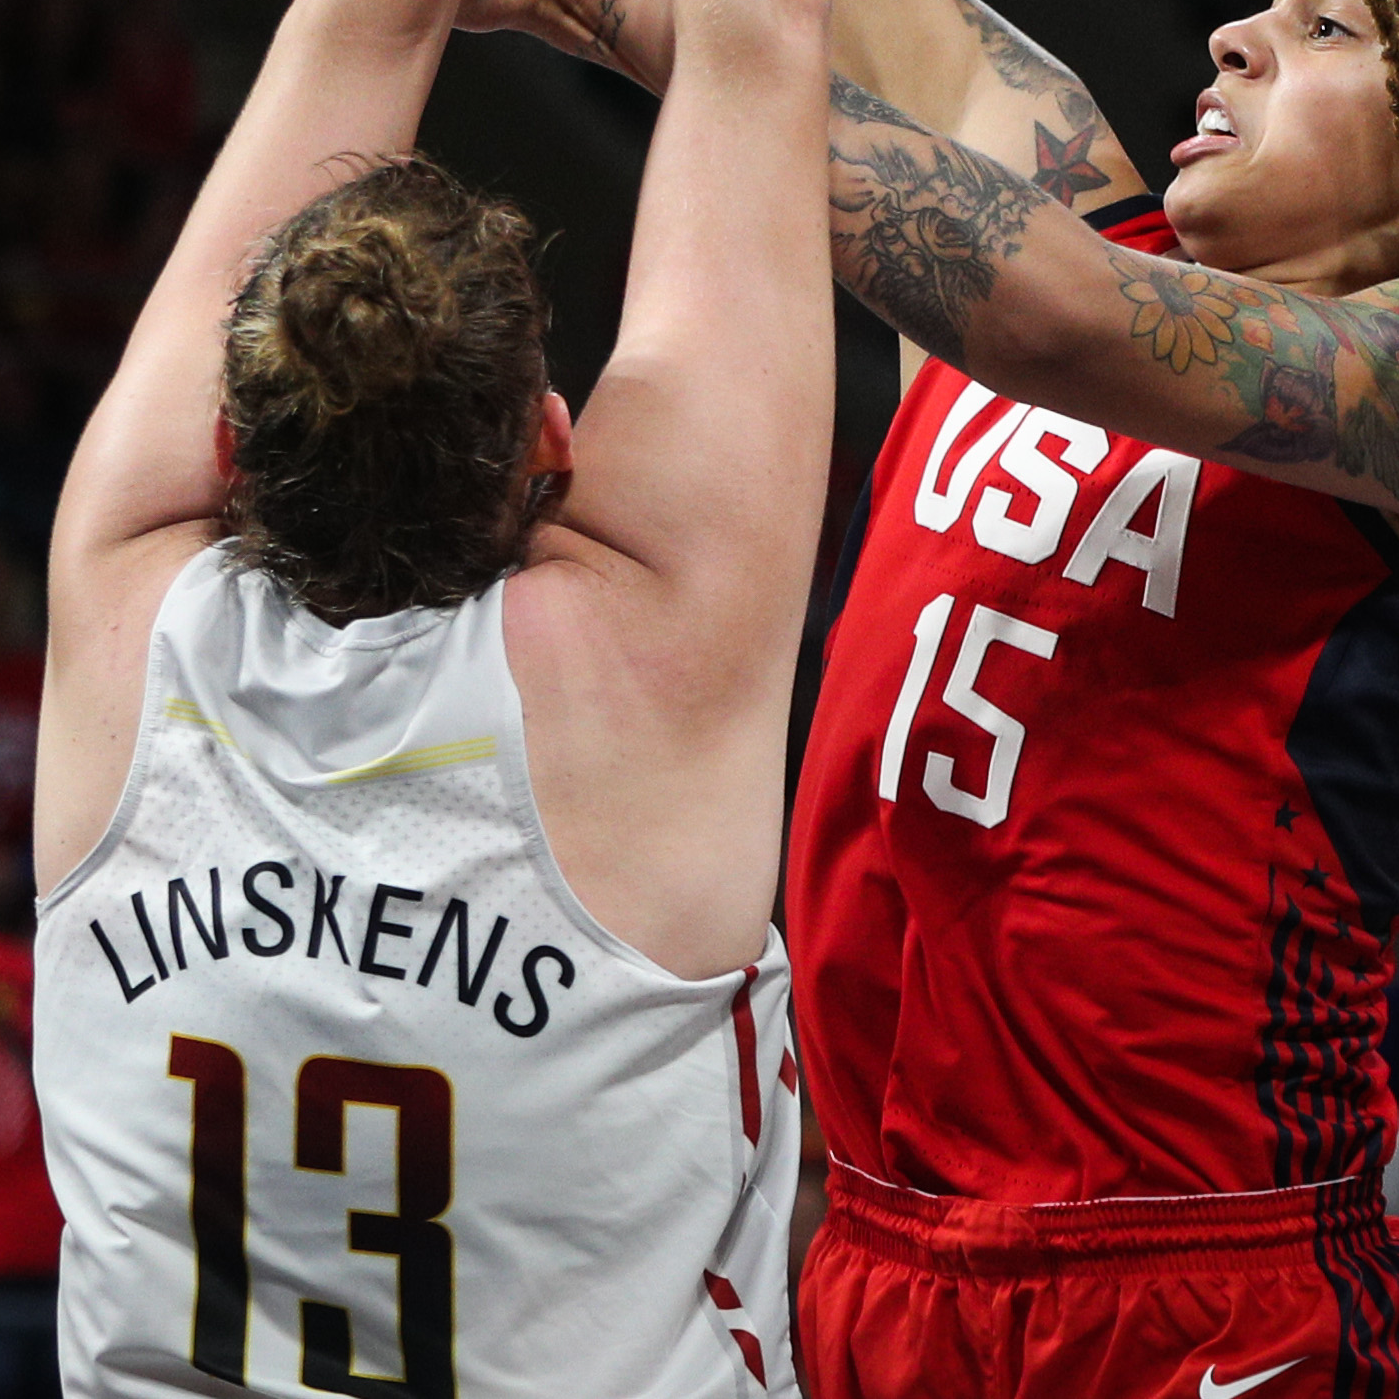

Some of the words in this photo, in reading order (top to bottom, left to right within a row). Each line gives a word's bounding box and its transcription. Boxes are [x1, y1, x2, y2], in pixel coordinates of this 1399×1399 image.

[912, 380, 1201, 619] USA
[879, 592, 1059, 828] 15
[90, 860, 576, 1039] LINSKENS
[166, 1031, 460, 1399] 13
